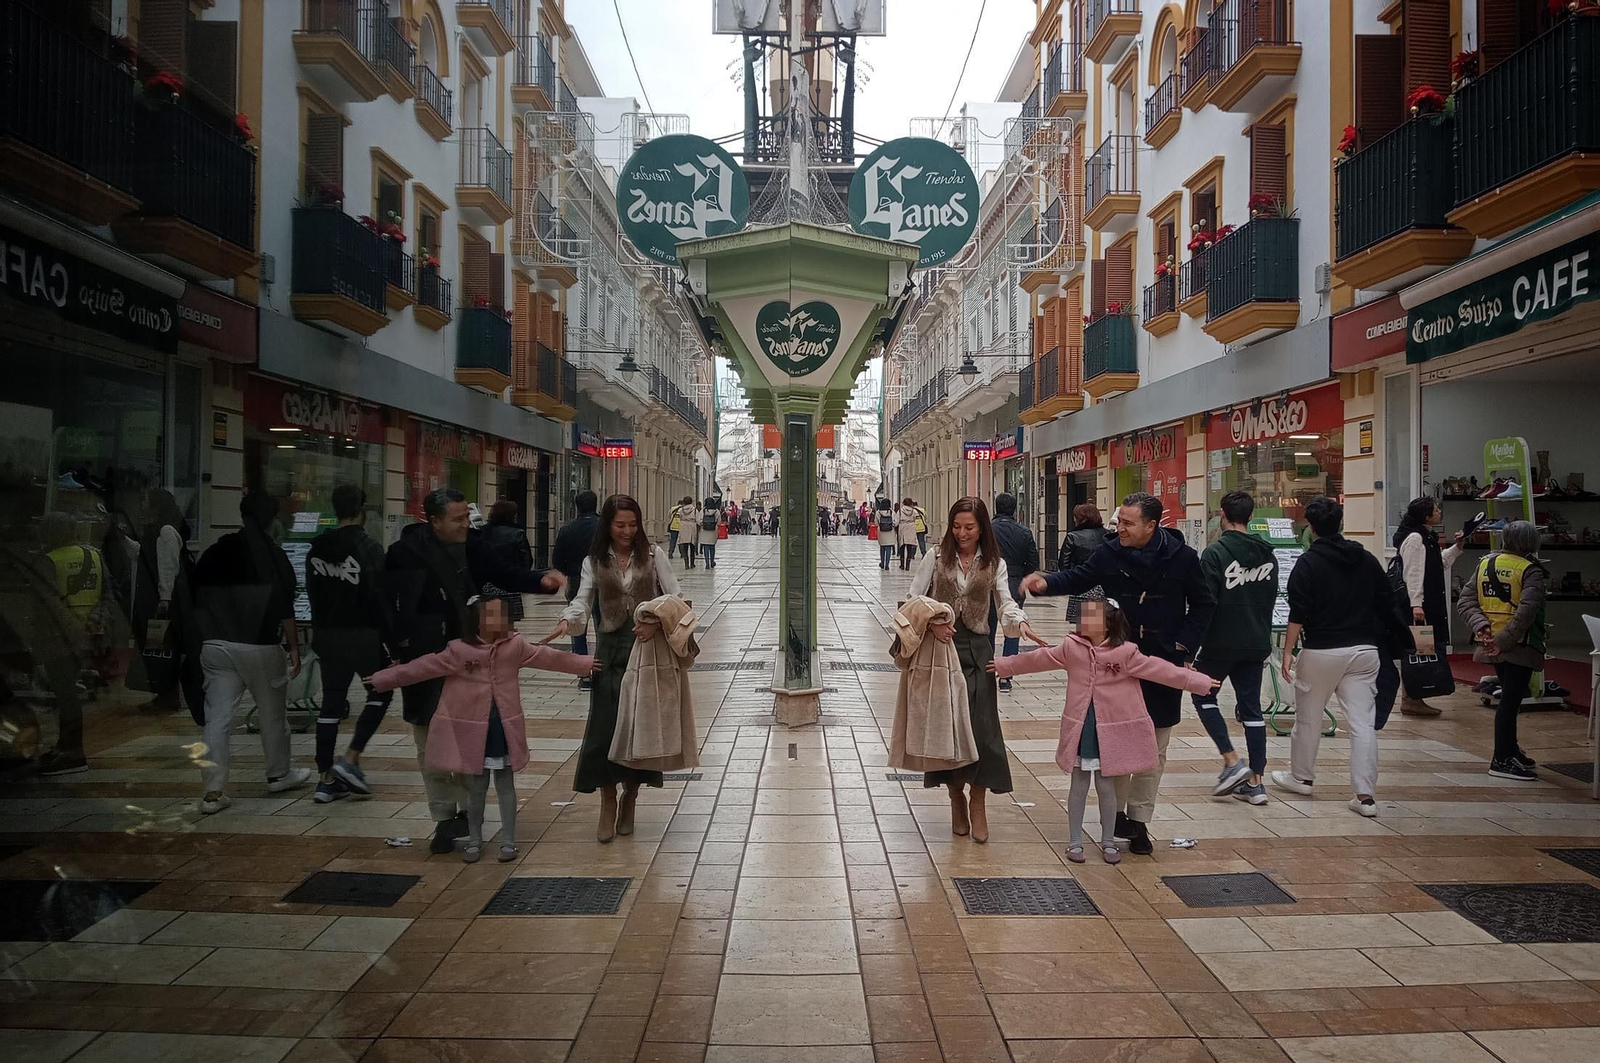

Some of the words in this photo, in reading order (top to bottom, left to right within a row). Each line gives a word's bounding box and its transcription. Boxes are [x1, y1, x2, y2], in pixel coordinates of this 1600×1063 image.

[925, 169, 966, 185] Tiendas
[931, 249, 946, 261] 1915
[1412, 315, 1454, 344] Centro
[1512, 250, 1589, 320] CAFE
[967, 450, 990, 460] 16:33
